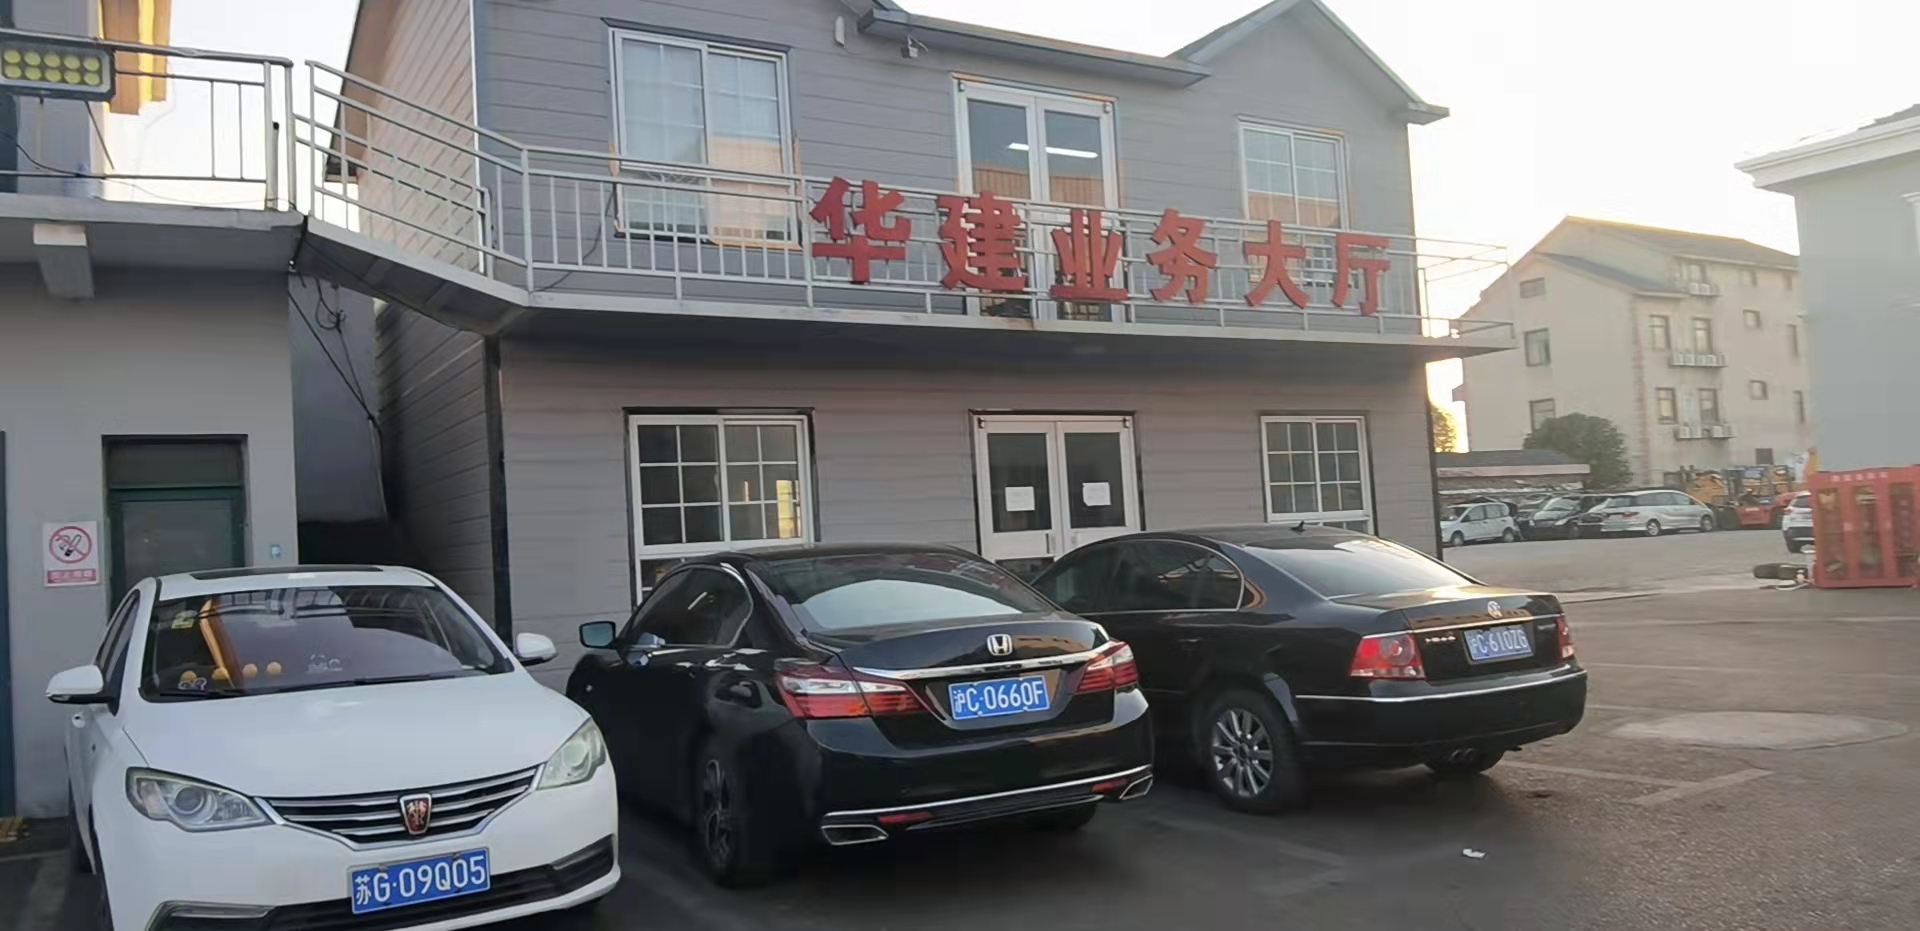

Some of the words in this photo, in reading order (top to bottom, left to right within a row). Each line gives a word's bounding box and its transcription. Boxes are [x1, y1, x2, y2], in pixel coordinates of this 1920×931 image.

[811, 176, 1391, 315] 华建业务大厅
